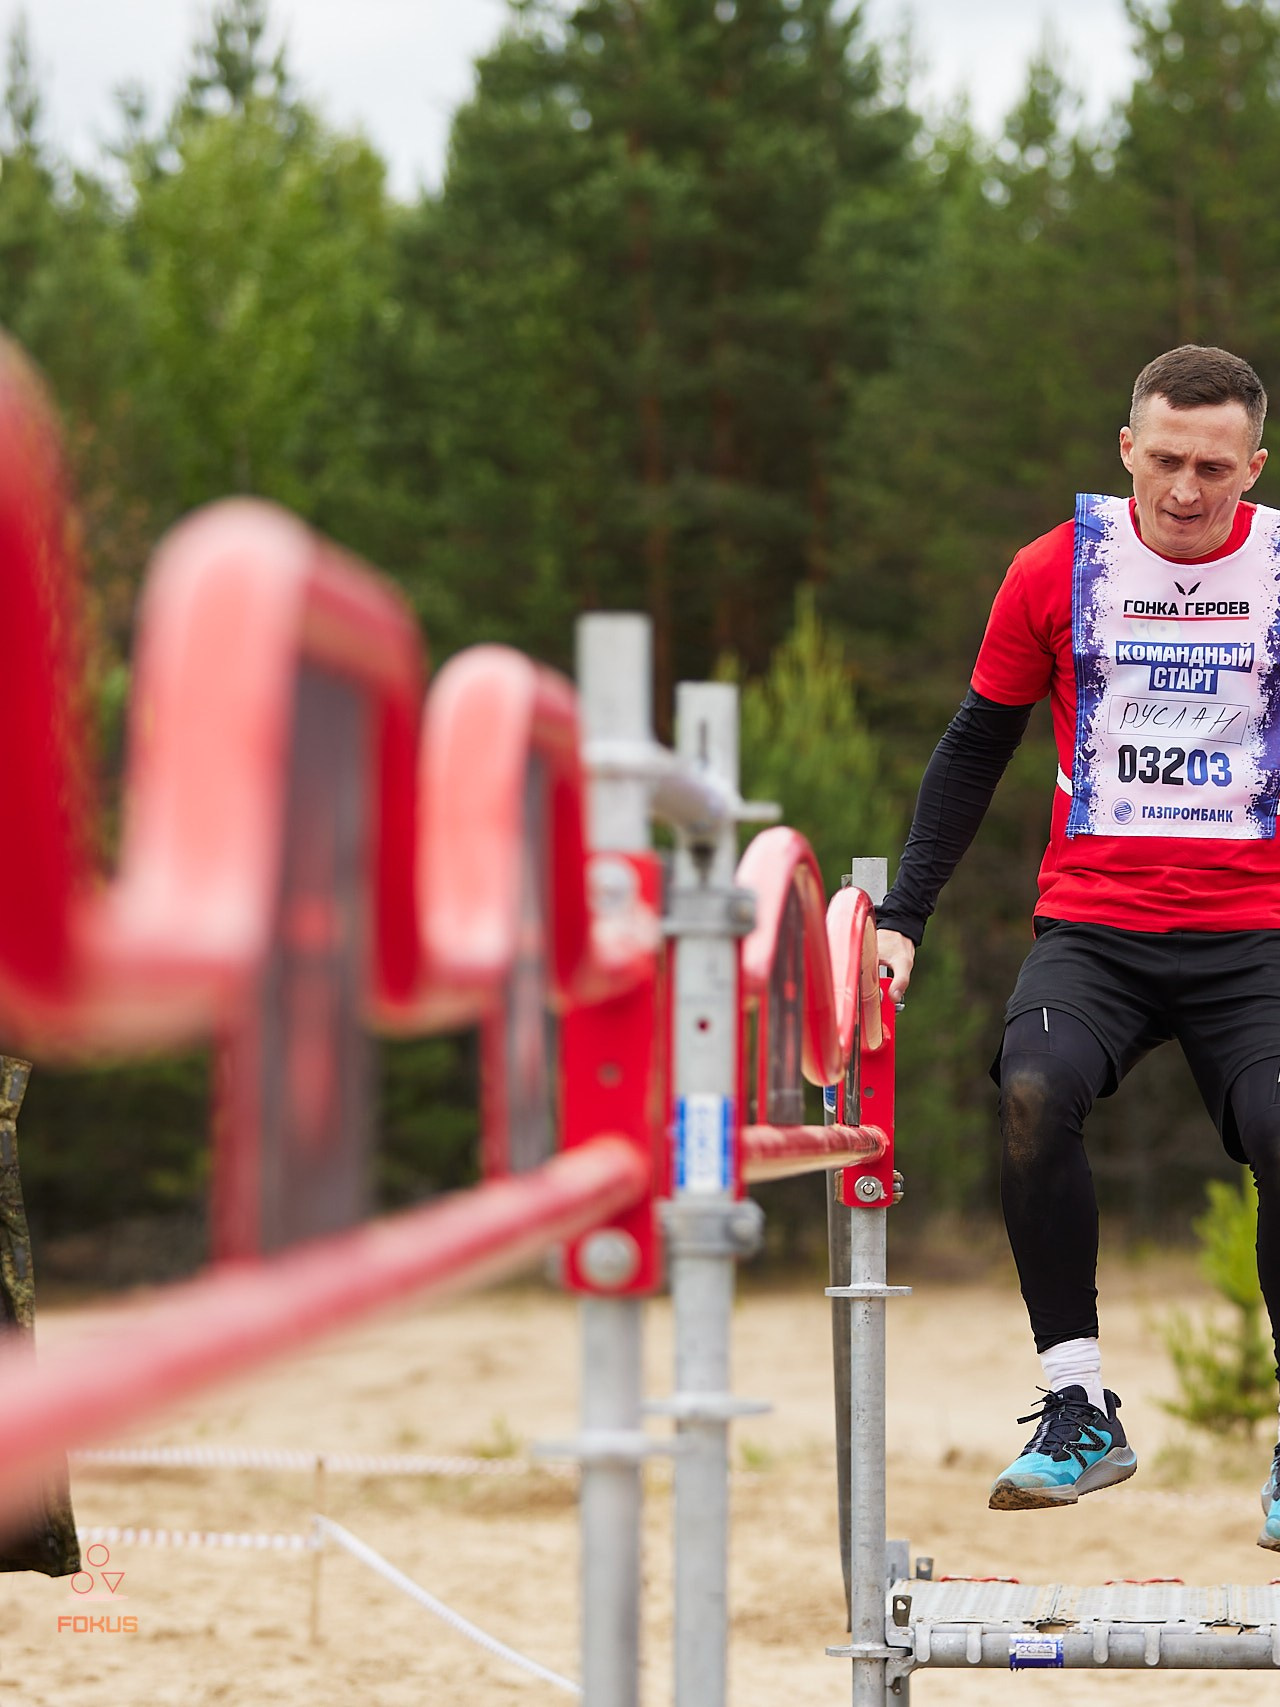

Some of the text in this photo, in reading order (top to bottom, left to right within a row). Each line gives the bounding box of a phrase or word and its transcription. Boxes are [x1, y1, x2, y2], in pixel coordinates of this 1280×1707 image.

[1123, 599, 1250, 616] ГОНКА ГЕРОЕВ
[1118, 642, 1253, 668] КОМАНДНЫЙ
[1153, 667, 1215, 693] СТАРТ
[1119, 702, 1242, 734] РУСЛАН
[1117, 744, 1233, 787] 03203
[1141, 805, 1234, 823] ГАЗПРОМБАНК
